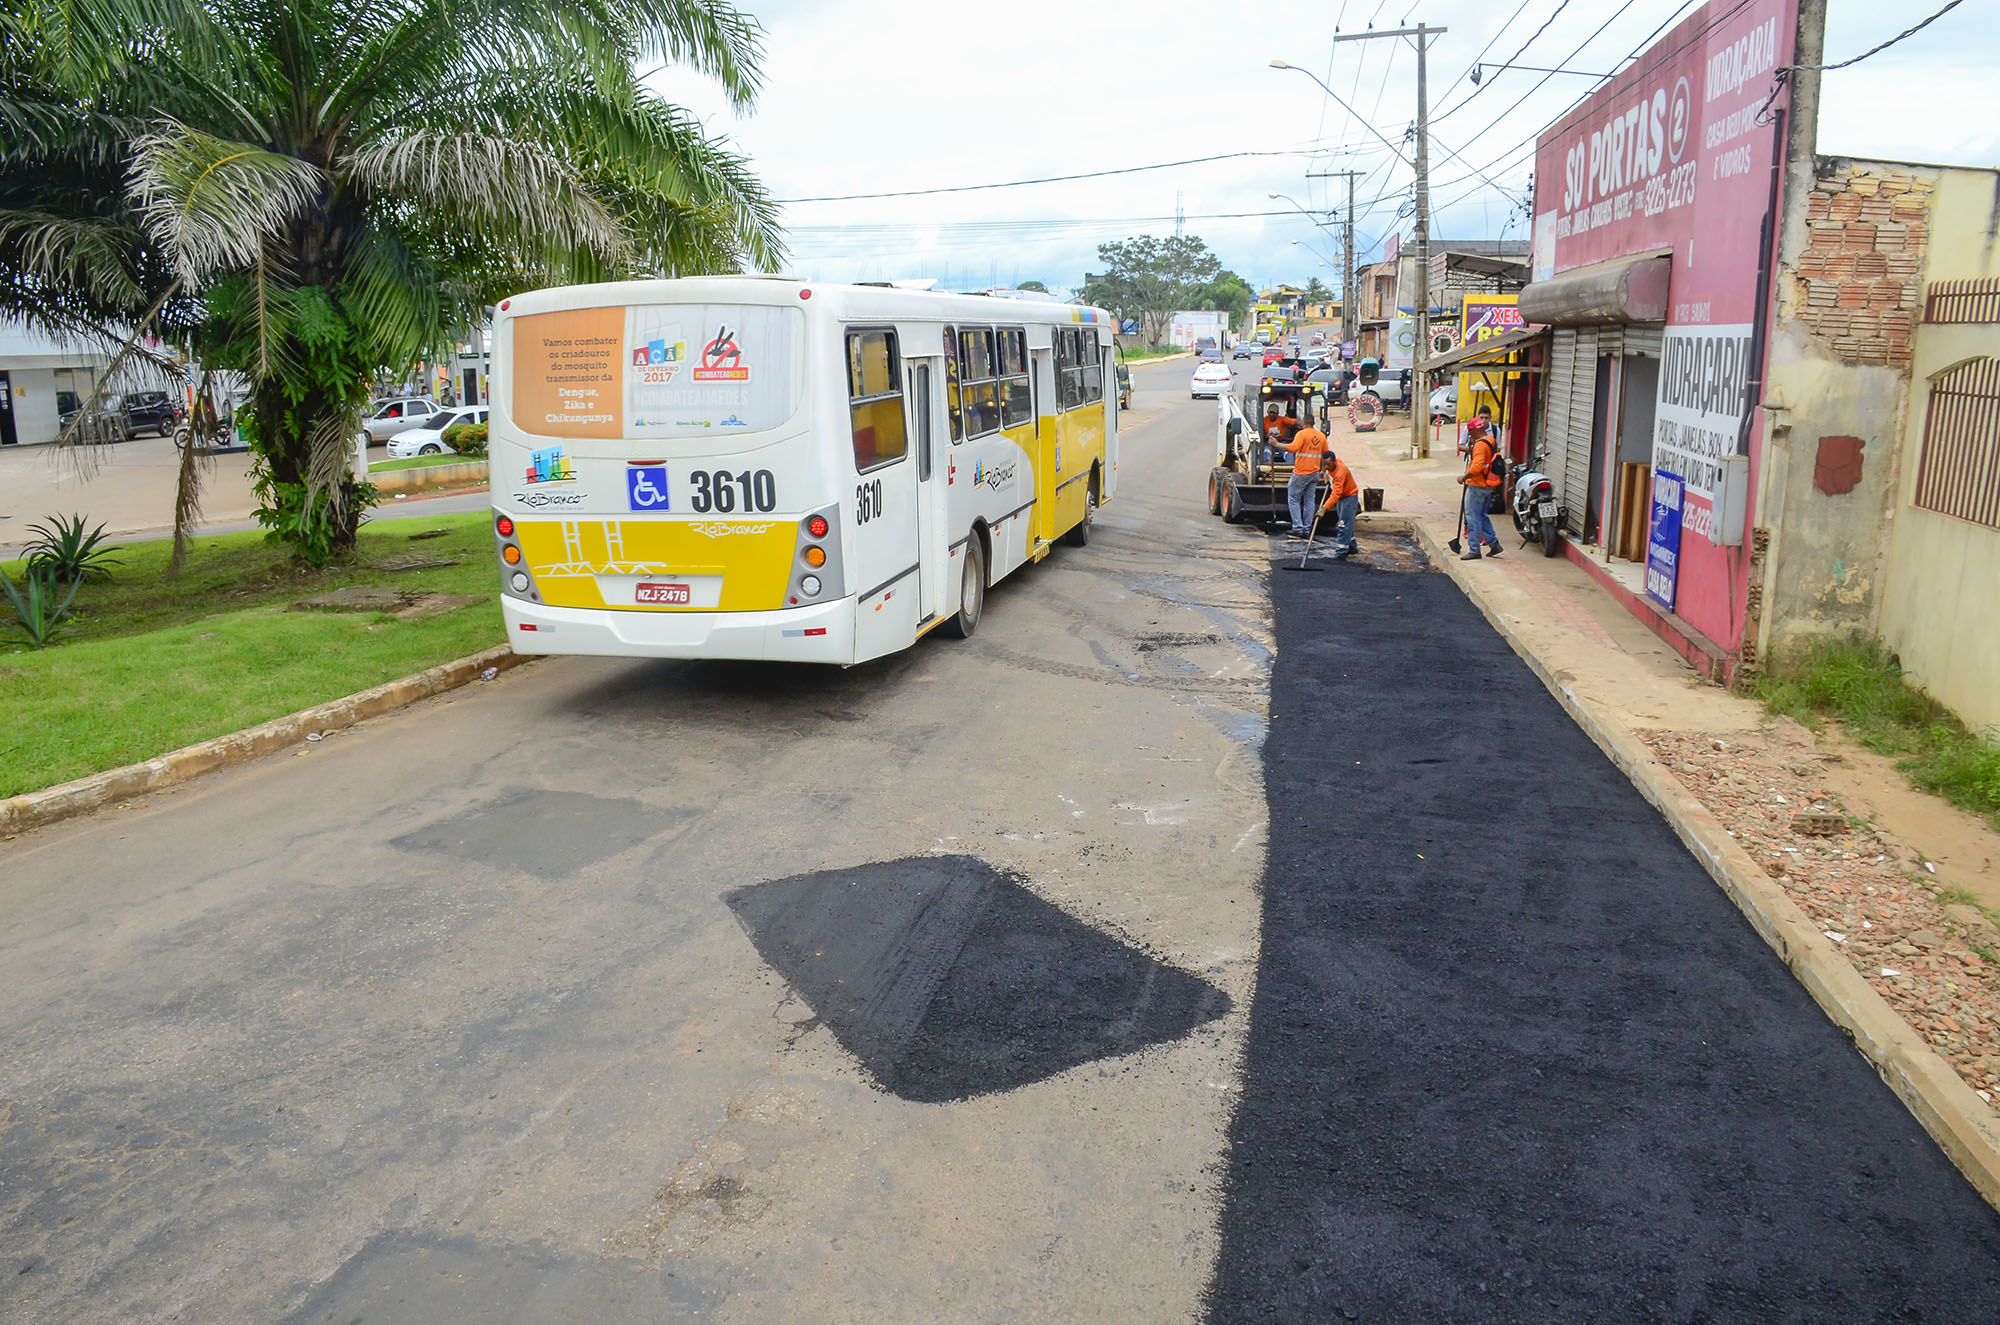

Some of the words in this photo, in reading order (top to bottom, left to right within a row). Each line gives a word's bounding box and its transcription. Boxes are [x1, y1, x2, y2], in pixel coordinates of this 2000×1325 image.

[1706, 15, 1775, 103] VIDRAÇARIA
[1707, 118, 1724, 149] CASA
[1564, 135, 1585, 213] SÓ
[1588, 88, 1666, 203] PORTAS
[1673, 98, 1684, 143] 2
[1720, 143, 1751, 178] VIDROS
[1491, 307, 1524, 325] XER
[543, 338, 572, 347] Vamos
[574, 337, 618, 346] combater
[561, 349, 610, 358] criadouros
[635, 346, 683, 365] AÇÃO
[551, 363, 563, 371] do
[565, 362, 607, 372] mosquito
[546, 374, 599, 383] transmissor
[602, 373, 613, 381] da
[644, 372, 672, 382] 2017
[1662, 336, 1753, 418] VIDRAÇARIA
[559, 387, 600, 398] Dengue,
[564, 400, 586, 409] Zika
[545, 413, 614, 424] Chikungunya
[1708, 430, 1724, 459] BOX
[690, 469, 776, 513] 3610
[856, 478, 882, 526] 3610
